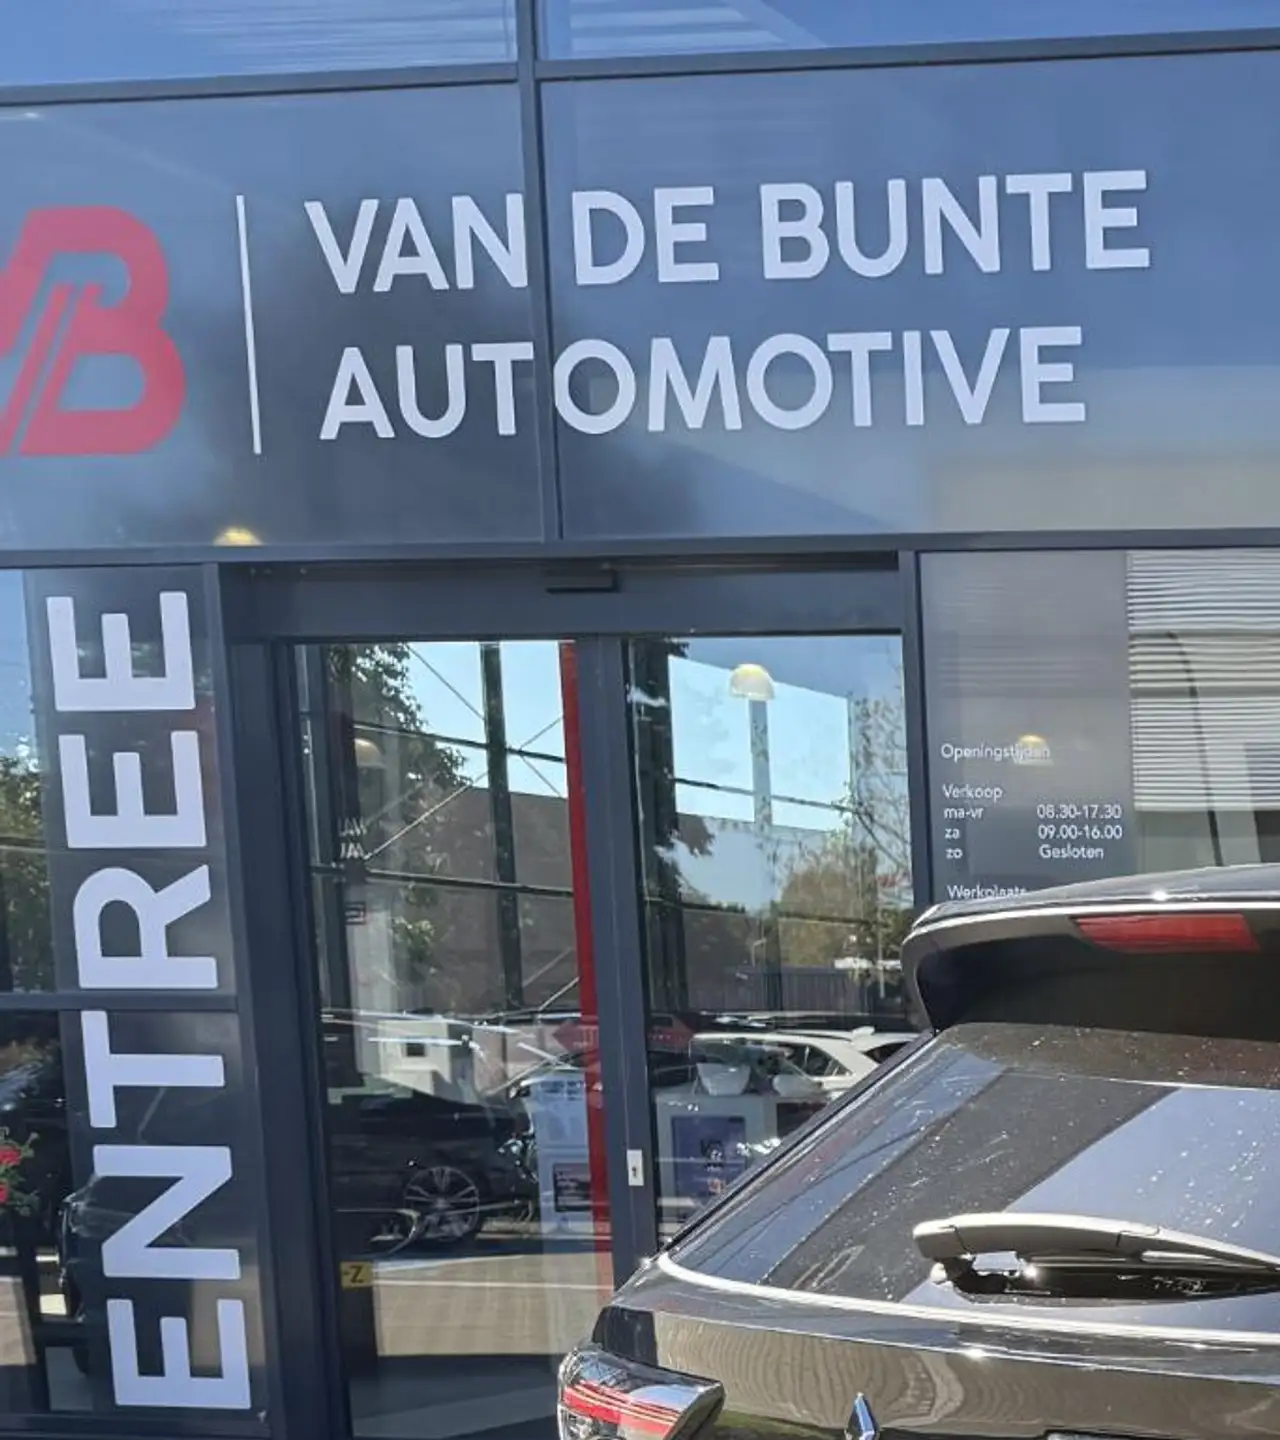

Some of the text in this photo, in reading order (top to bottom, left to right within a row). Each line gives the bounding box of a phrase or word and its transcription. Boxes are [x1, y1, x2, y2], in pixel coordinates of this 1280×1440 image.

[304, 170, 1150, 293] VAN DE BUNTE
[319, 326, 1086, 439] AUTOMOTIVE
[941, 743, 1050, 762] Openingstijden
[943, 784, 1003, 802] Verkoop
[944, 804, 1122, 819] ma-vr 08.30-17.30
[945, 825, 1123, 839] za 09.00-16.00
[946, 844, 1104, 859] zo Gesloten
[47, 591, 252, 1410] ENTREE
